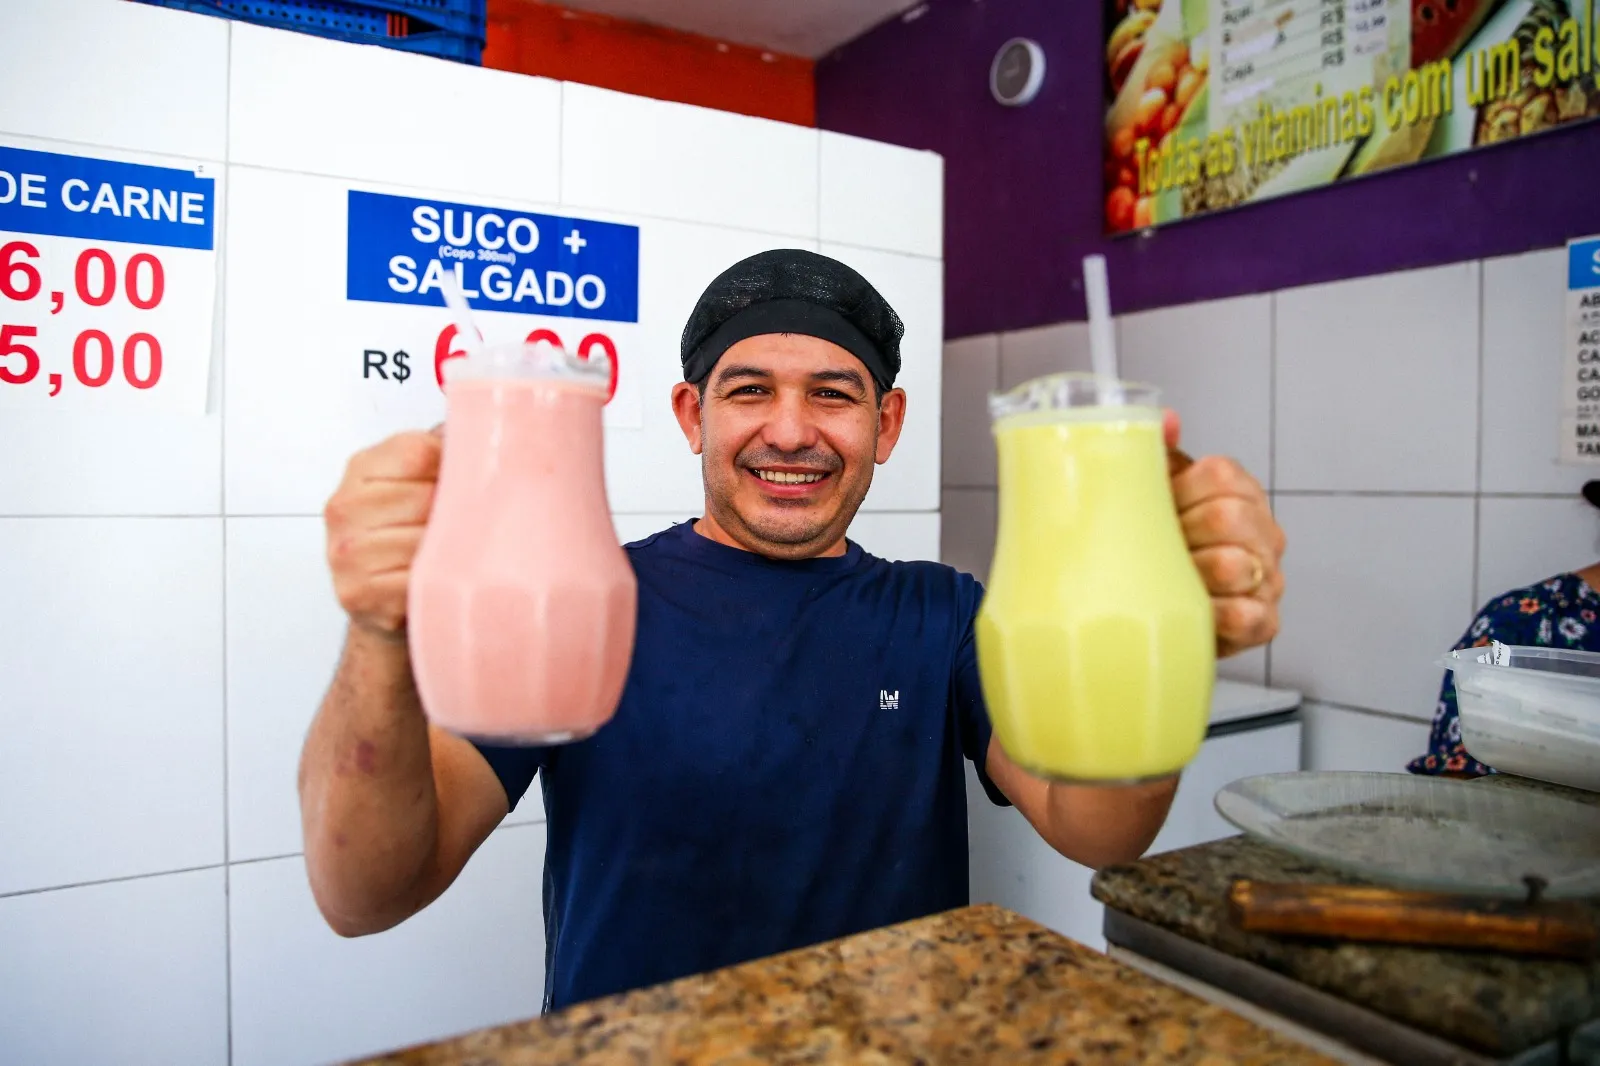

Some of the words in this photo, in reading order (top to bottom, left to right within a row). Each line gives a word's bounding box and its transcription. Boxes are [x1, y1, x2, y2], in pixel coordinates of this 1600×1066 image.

[1134, 131, 1201, 195] Todas
[1206, 125, 1235, 177] as
[1241, 82, 1375, 167] vitaminas
[1384, 57, 1453, 131] com
[1465, 38, 1521, 109] um
[0, 170, 47, 209] DE
[60, 178, 206, 226] CARNE
[411, 205, 540, 254] SUCO
[0, 240, 165, 315] 6,00
[387, 254, 607, 310] SALGADO
[0, 324, 163, 397] 5,00
[363, 349, 412, 384] R$
